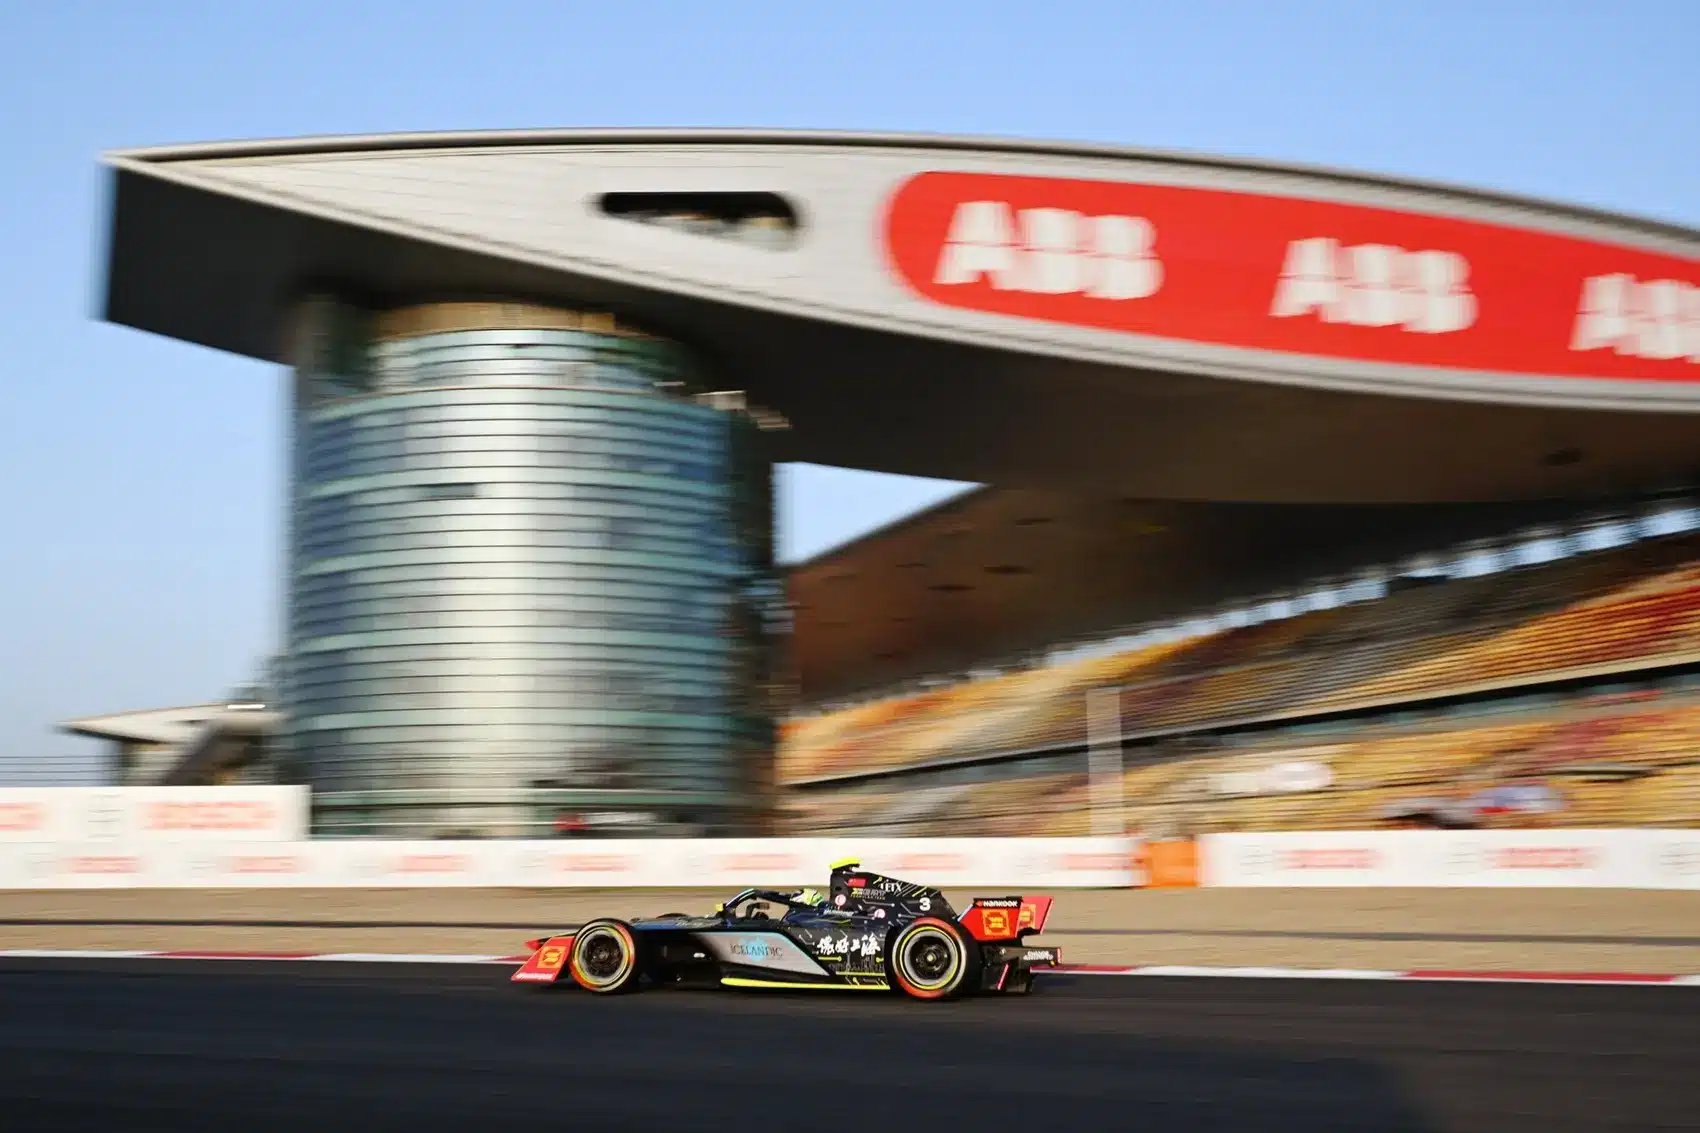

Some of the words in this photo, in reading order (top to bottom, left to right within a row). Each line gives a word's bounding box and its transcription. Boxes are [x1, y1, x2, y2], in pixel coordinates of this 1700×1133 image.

[934, 201, 1162, 300] ABB
[1271, 238, 1476, 333] ABB
[1569, 273, 1700, 365] AB
[919, 897, 931, 911] 3
